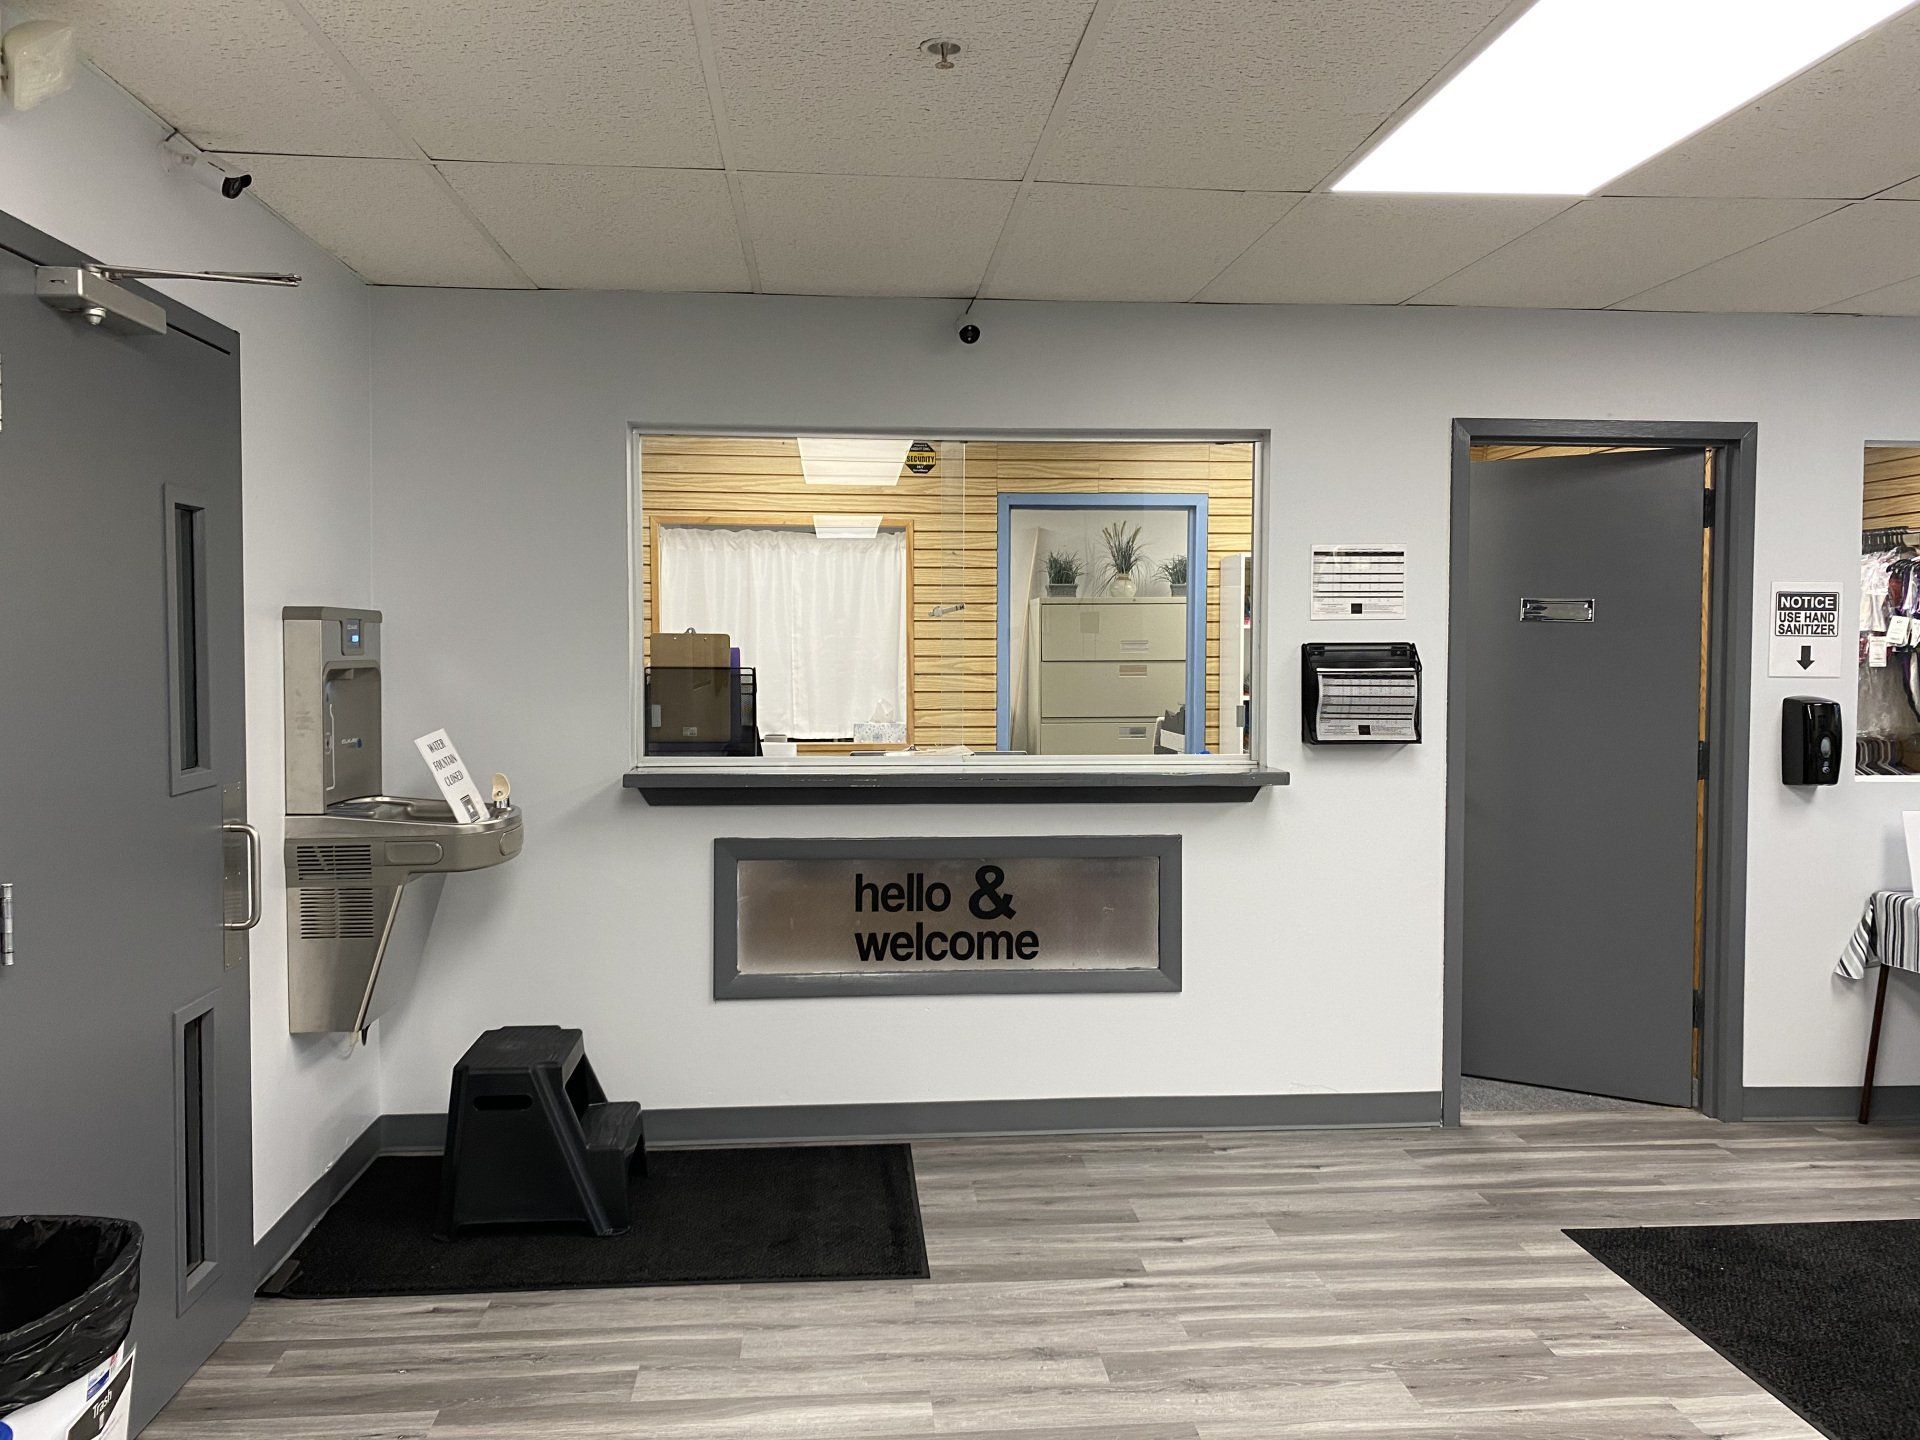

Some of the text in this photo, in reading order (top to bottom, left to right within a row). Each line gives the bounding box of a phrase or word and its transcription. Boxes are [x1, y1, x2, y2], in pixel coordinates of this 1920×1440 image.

[906, 455, 935, 463] SECURITY
[1780, 596, 1834, 609] NOTICE
[1779, 612, 1835, 623] USE HAND
[1778, 624, 1835, 635] SANITIZER
[426, 738, 446, 754] WATER
[432, 753, 458, 772] FOUNTAIN
[443, 769, 464, 787] CLOSED
[855, 864, 1017, 920] hello &
[855, 922, 1039, 962] welcome
[92, 1389, 113, 1419] Trash
